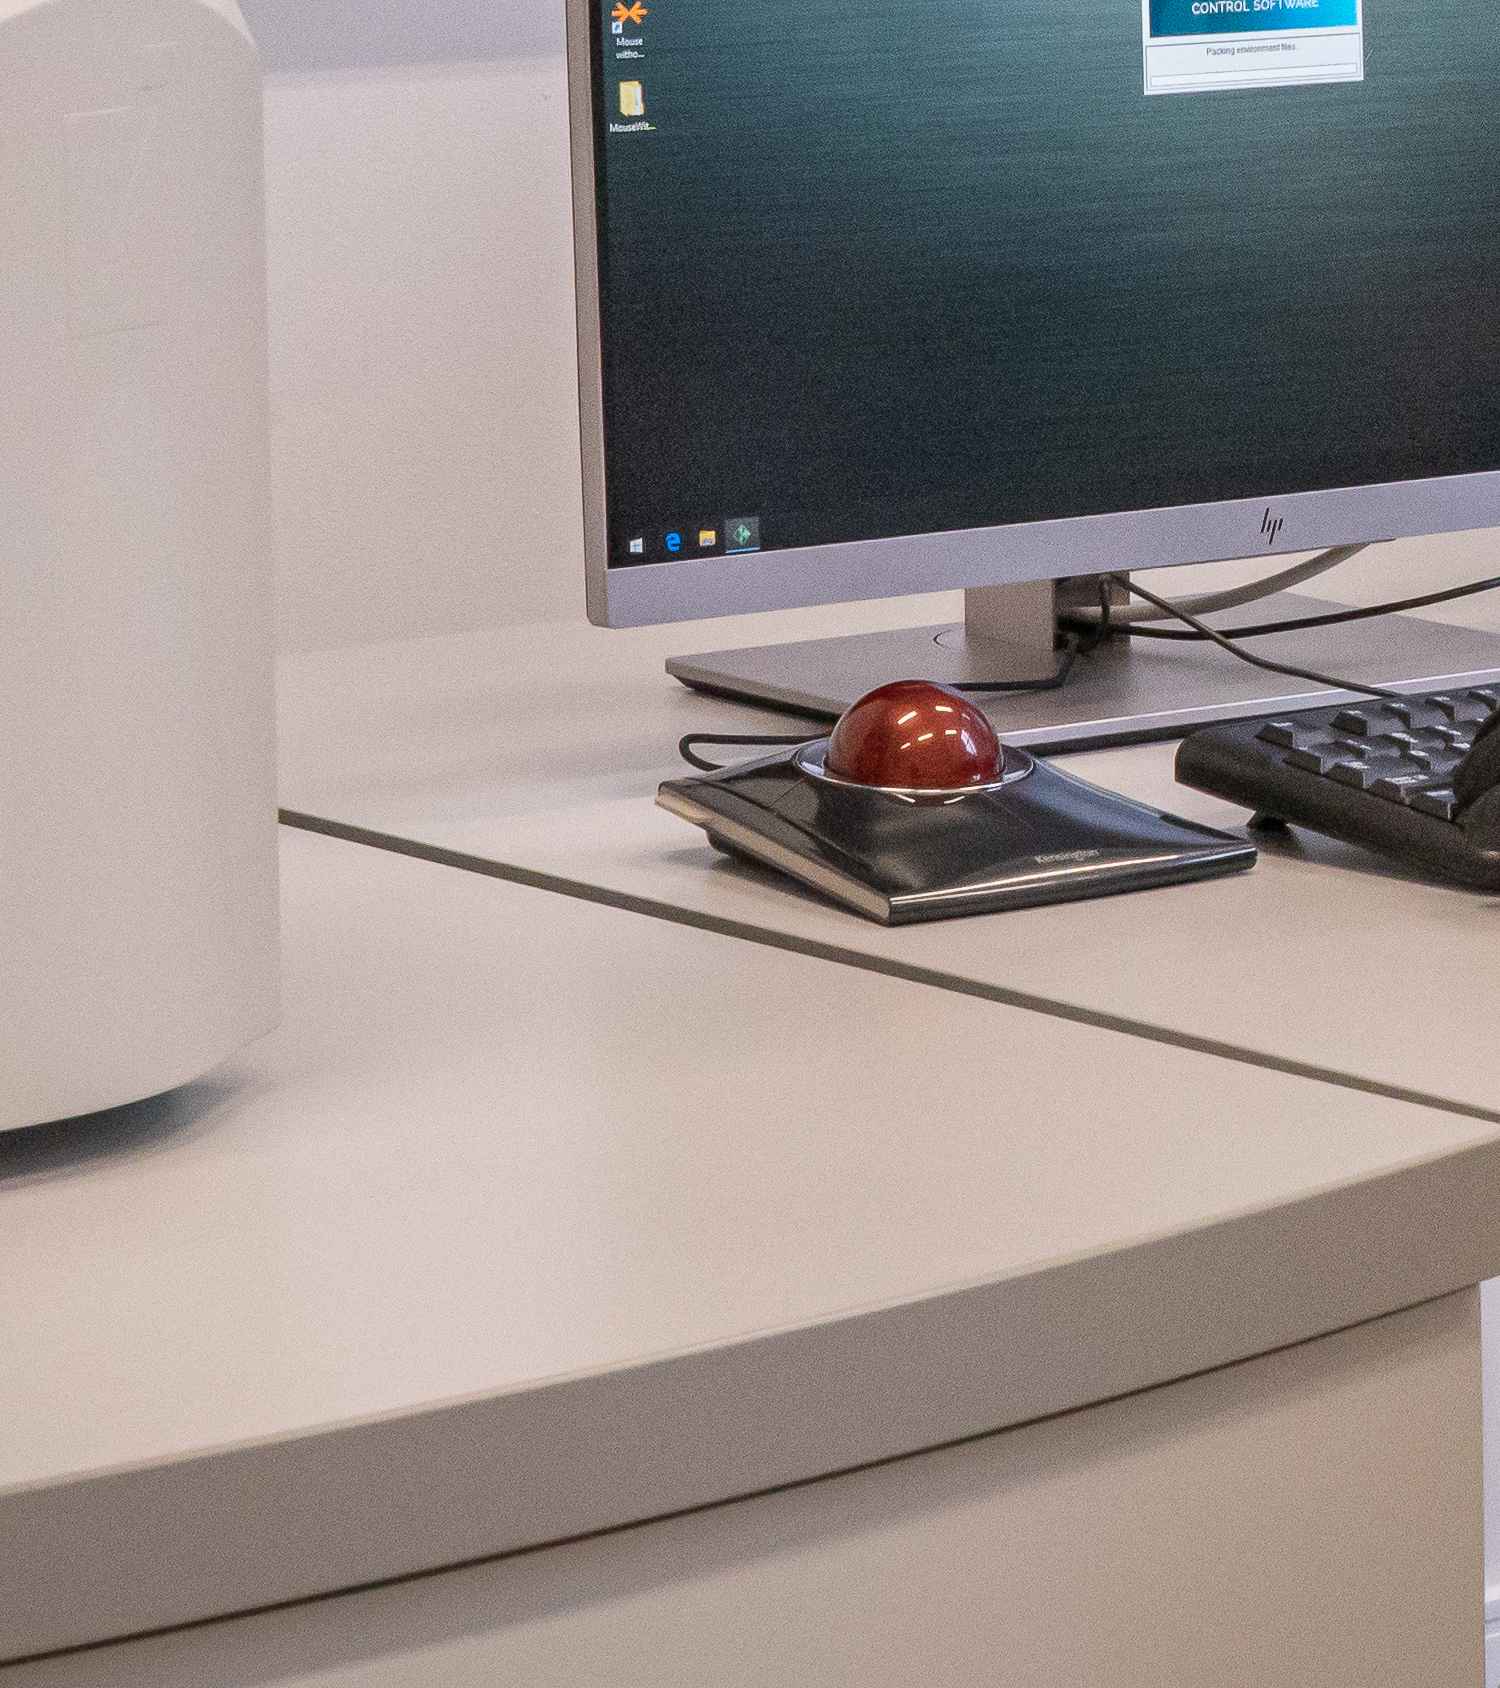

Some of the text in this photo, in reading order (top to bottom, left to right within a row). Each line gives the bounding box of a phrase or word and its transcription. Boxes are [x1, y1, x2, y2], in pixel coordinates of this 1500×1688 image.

[1191, 0, 1250, 15] CONTROL
[616, 37, 643, 47] Mouse
[1206, 46, 1235, 56] Packing
[1237, 43, 1280, 54] environment
